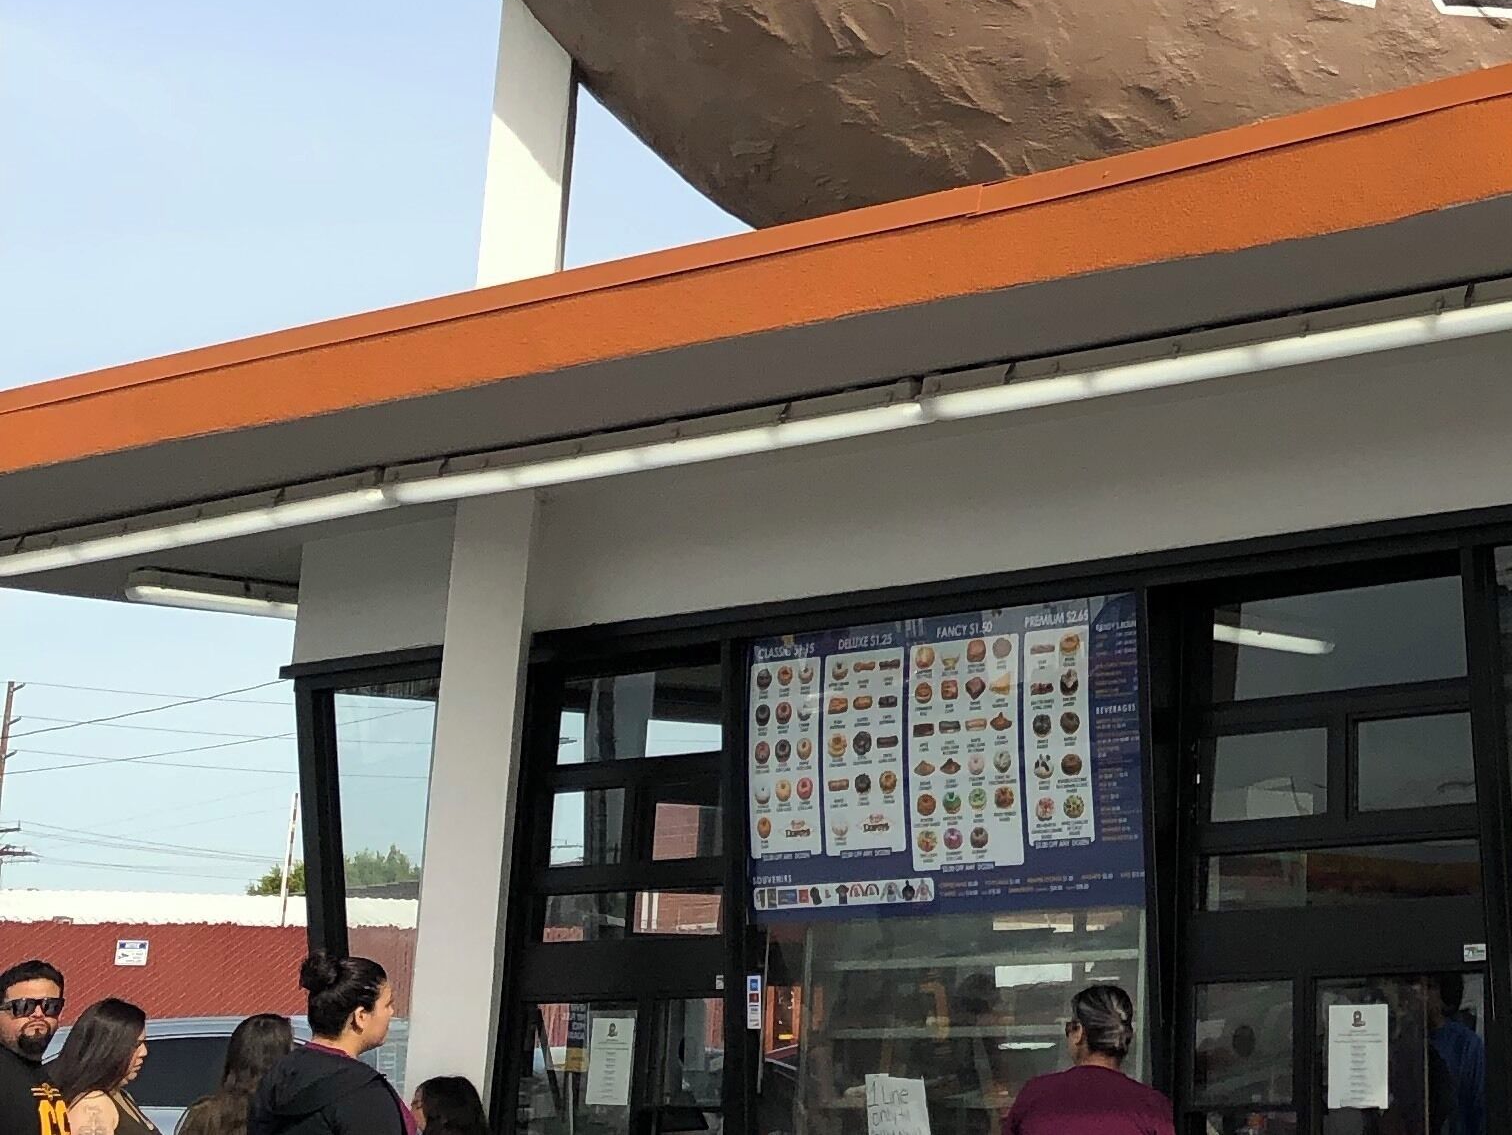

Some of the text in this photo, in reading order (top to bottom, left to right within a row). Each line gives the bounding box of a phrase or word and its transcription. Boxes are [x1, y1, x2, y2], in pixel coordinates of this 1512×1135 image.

[1024, 612, 1065, 628] PREMIUM
[936, 620, 993, 639] FANCY $1.50
[838, 633, 893, 650] DELUXE $1.25
[1095, 703, 1137, 716] BEVERAGES
[752, 874, 792, 885] SOUVENIRS
